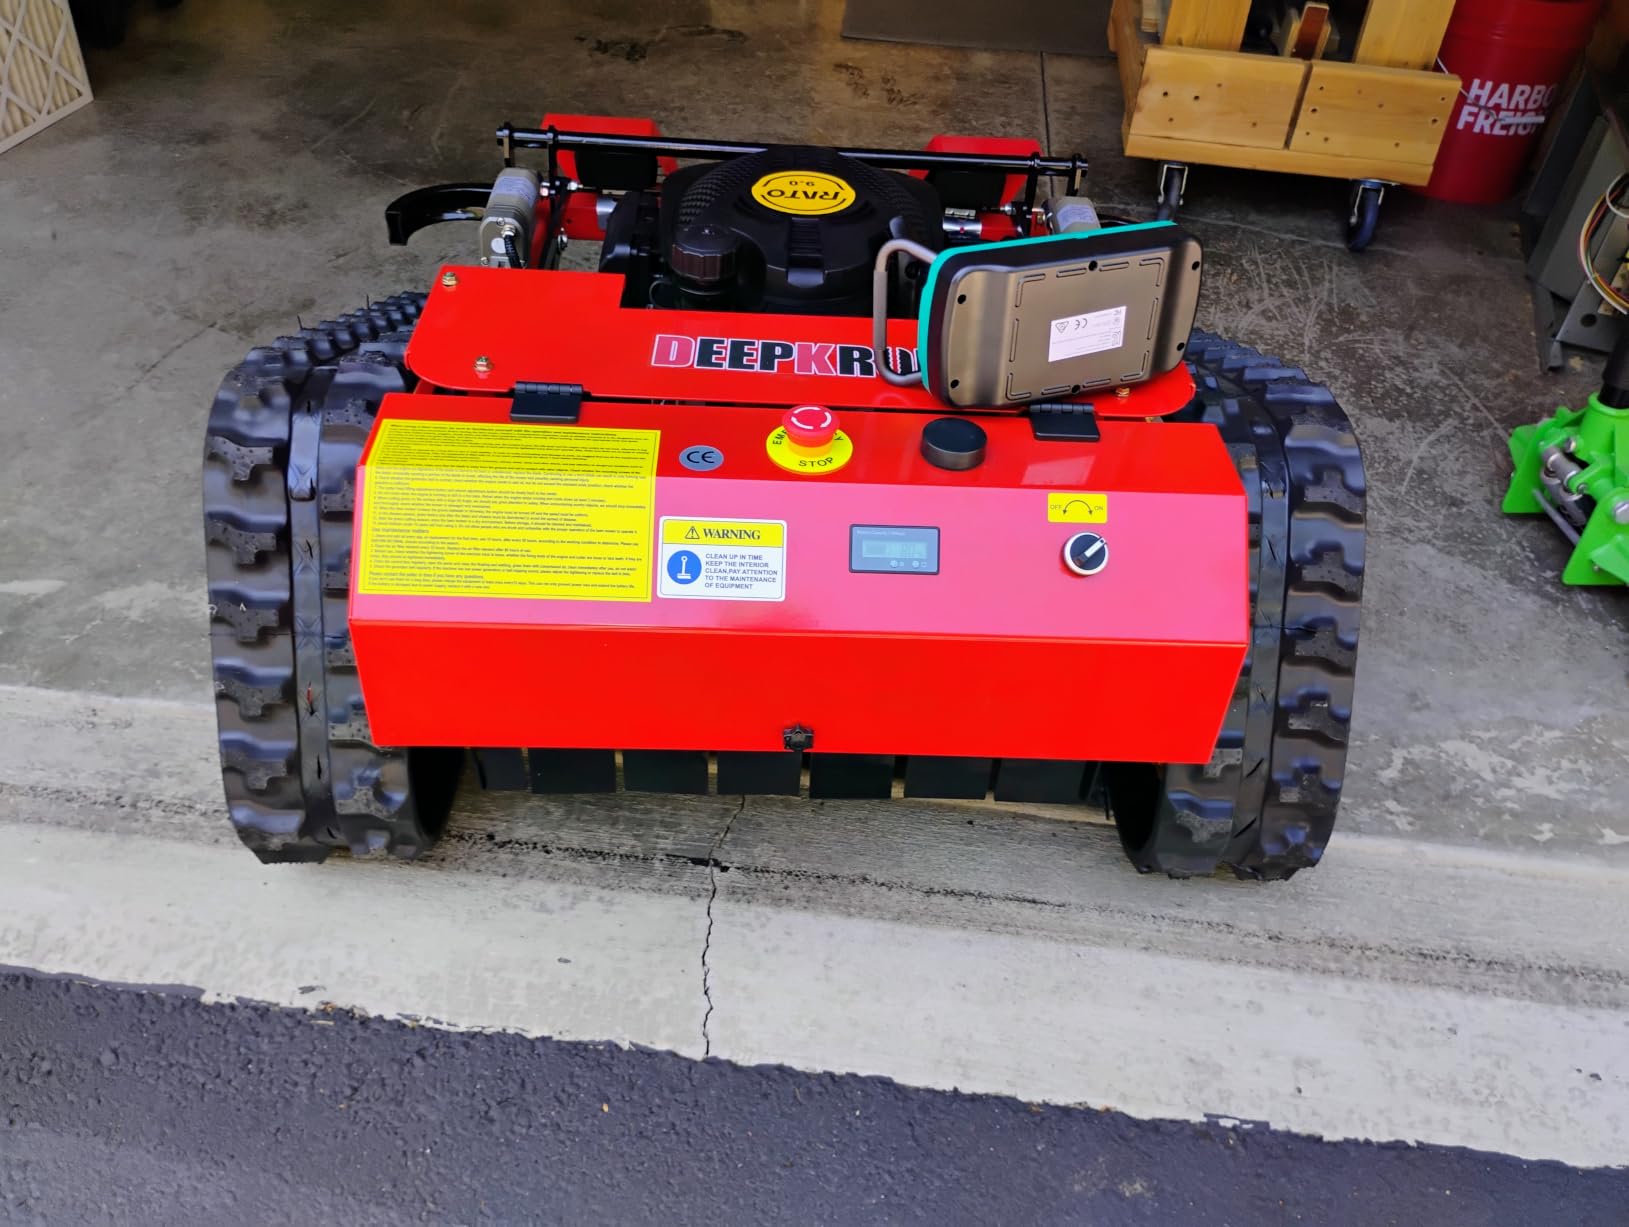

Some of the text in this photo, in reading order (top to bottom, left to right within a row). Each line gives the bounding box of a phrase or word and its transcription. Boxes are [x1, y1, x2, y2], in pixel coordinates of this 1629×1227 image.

[767, 189, 840, 200] RATO
[686, 450, 715, 464] CE
[798, 456, 834, 467] STOP
[703, 528, 761, 540] WARNING
[715, 582, 753, 590] EQUIPMENT
